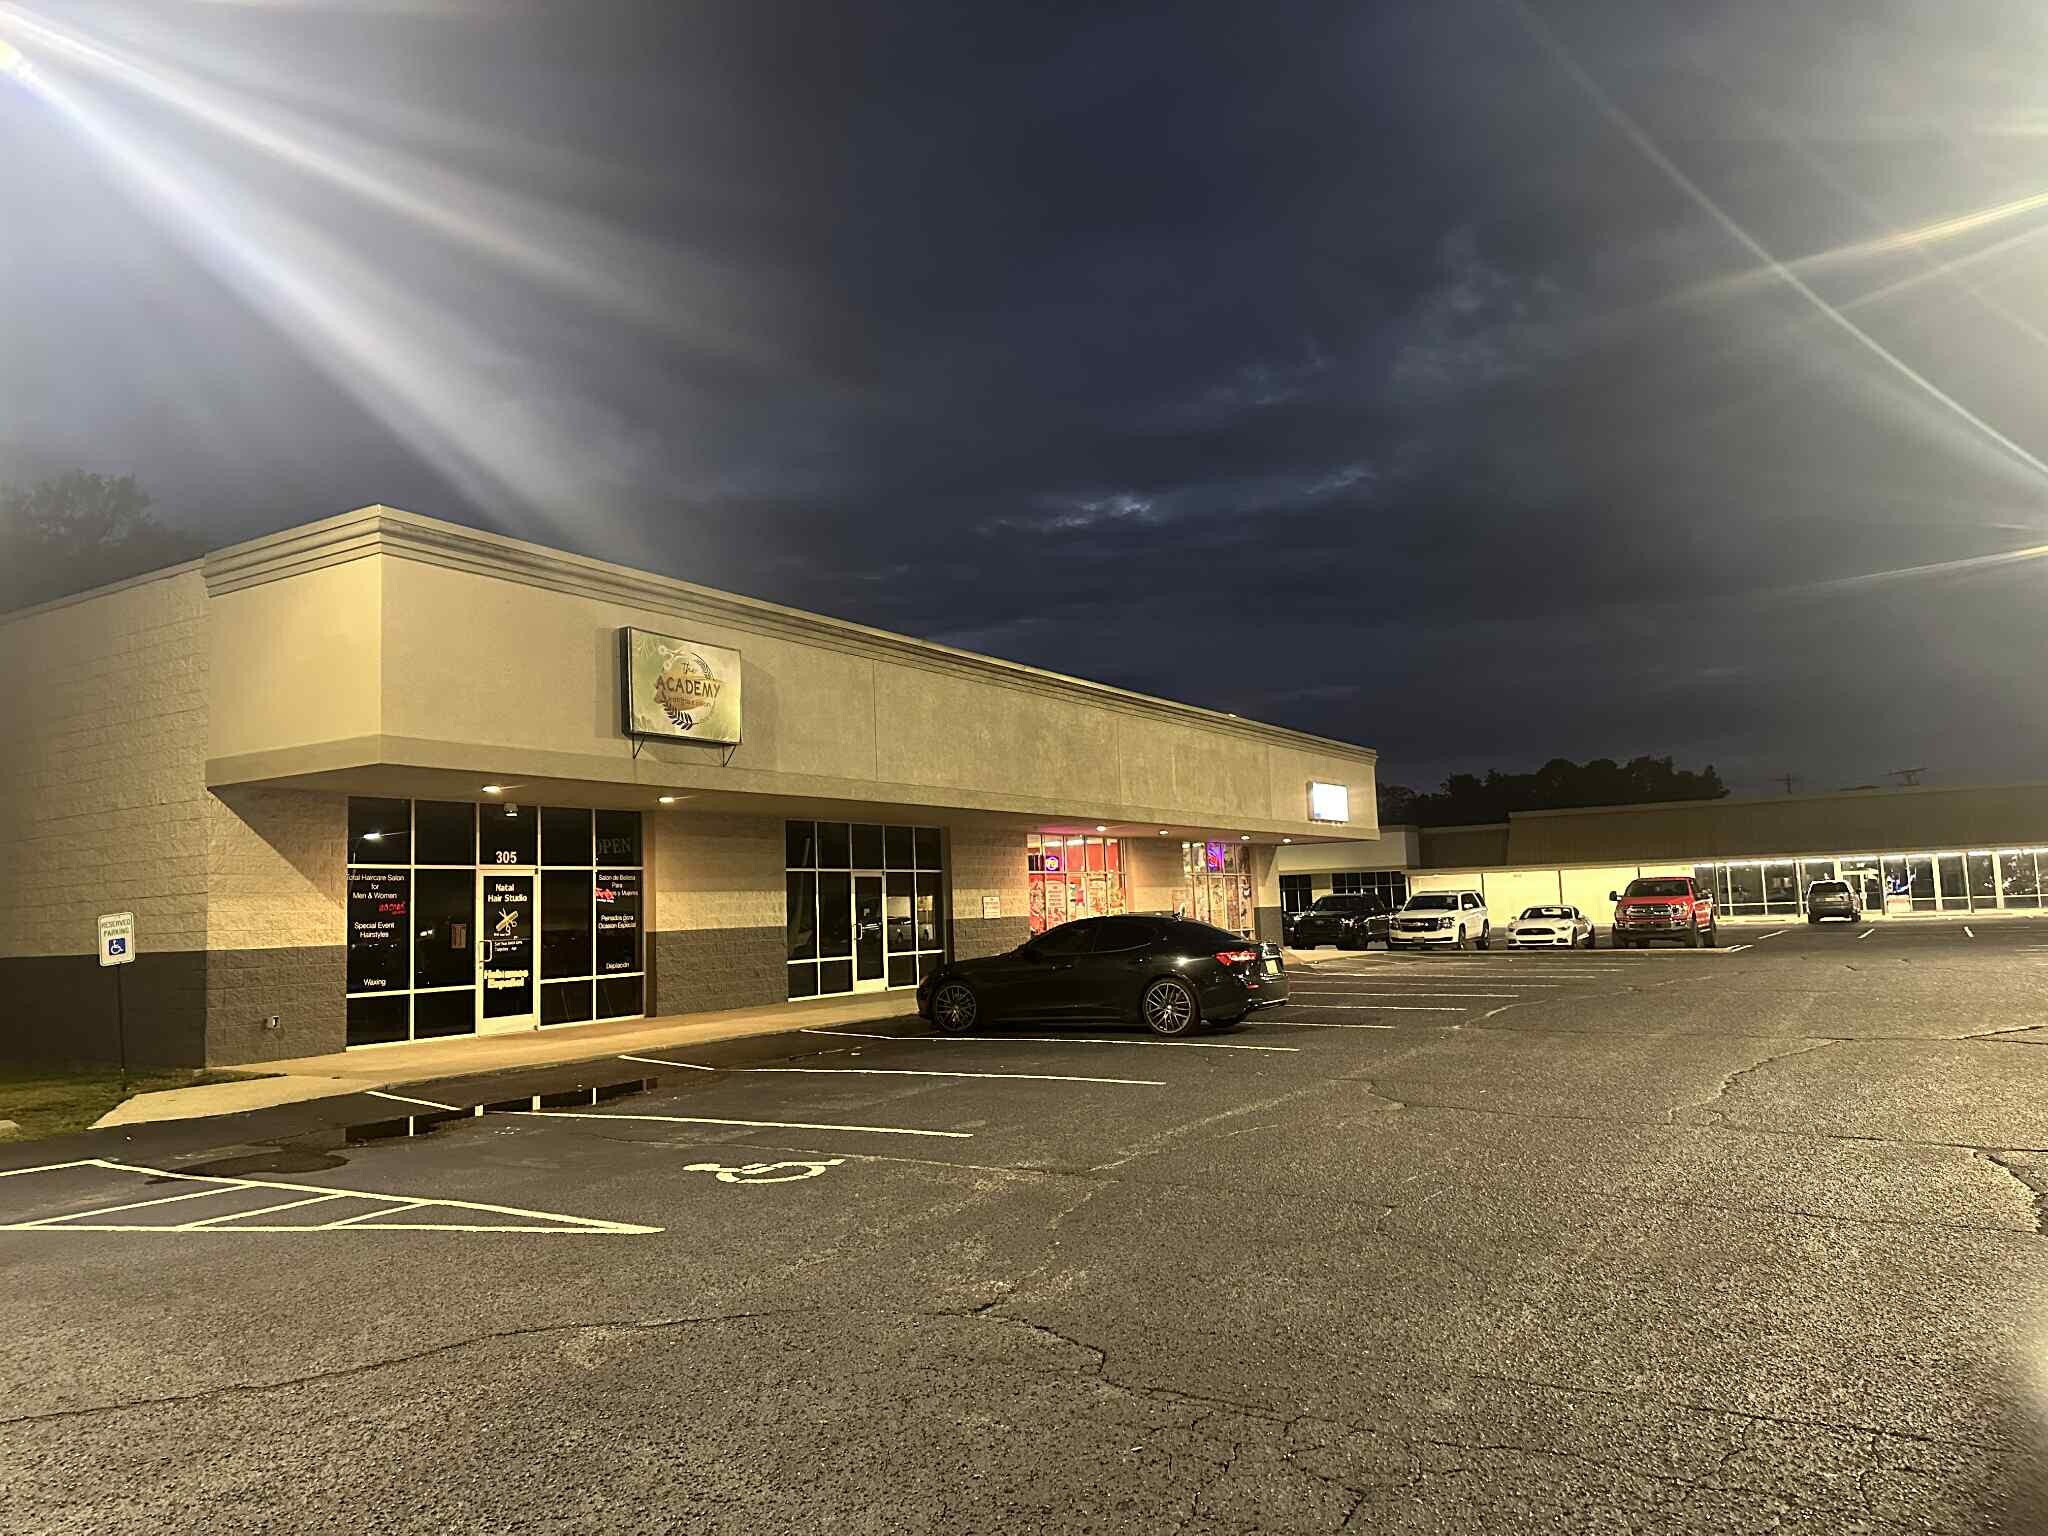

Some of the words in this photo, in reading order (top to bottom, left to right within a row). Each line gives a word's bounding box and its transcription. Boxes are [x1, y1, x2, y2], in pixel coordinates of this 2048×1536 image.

[655, 675, 721, 699] ACADEMY
[495, 850, 517, 864] 305
[495, 883, 515, 892] Natal
[487, 894, 503, 903] Hair
[503, 893, 528, 902] Studio
[354, 921, 377, 930] Special
[377, 921, 395, 929] Event
[359, 931, 390, 940] Hairstyles
[363, 979, 387, 987] Waxing
